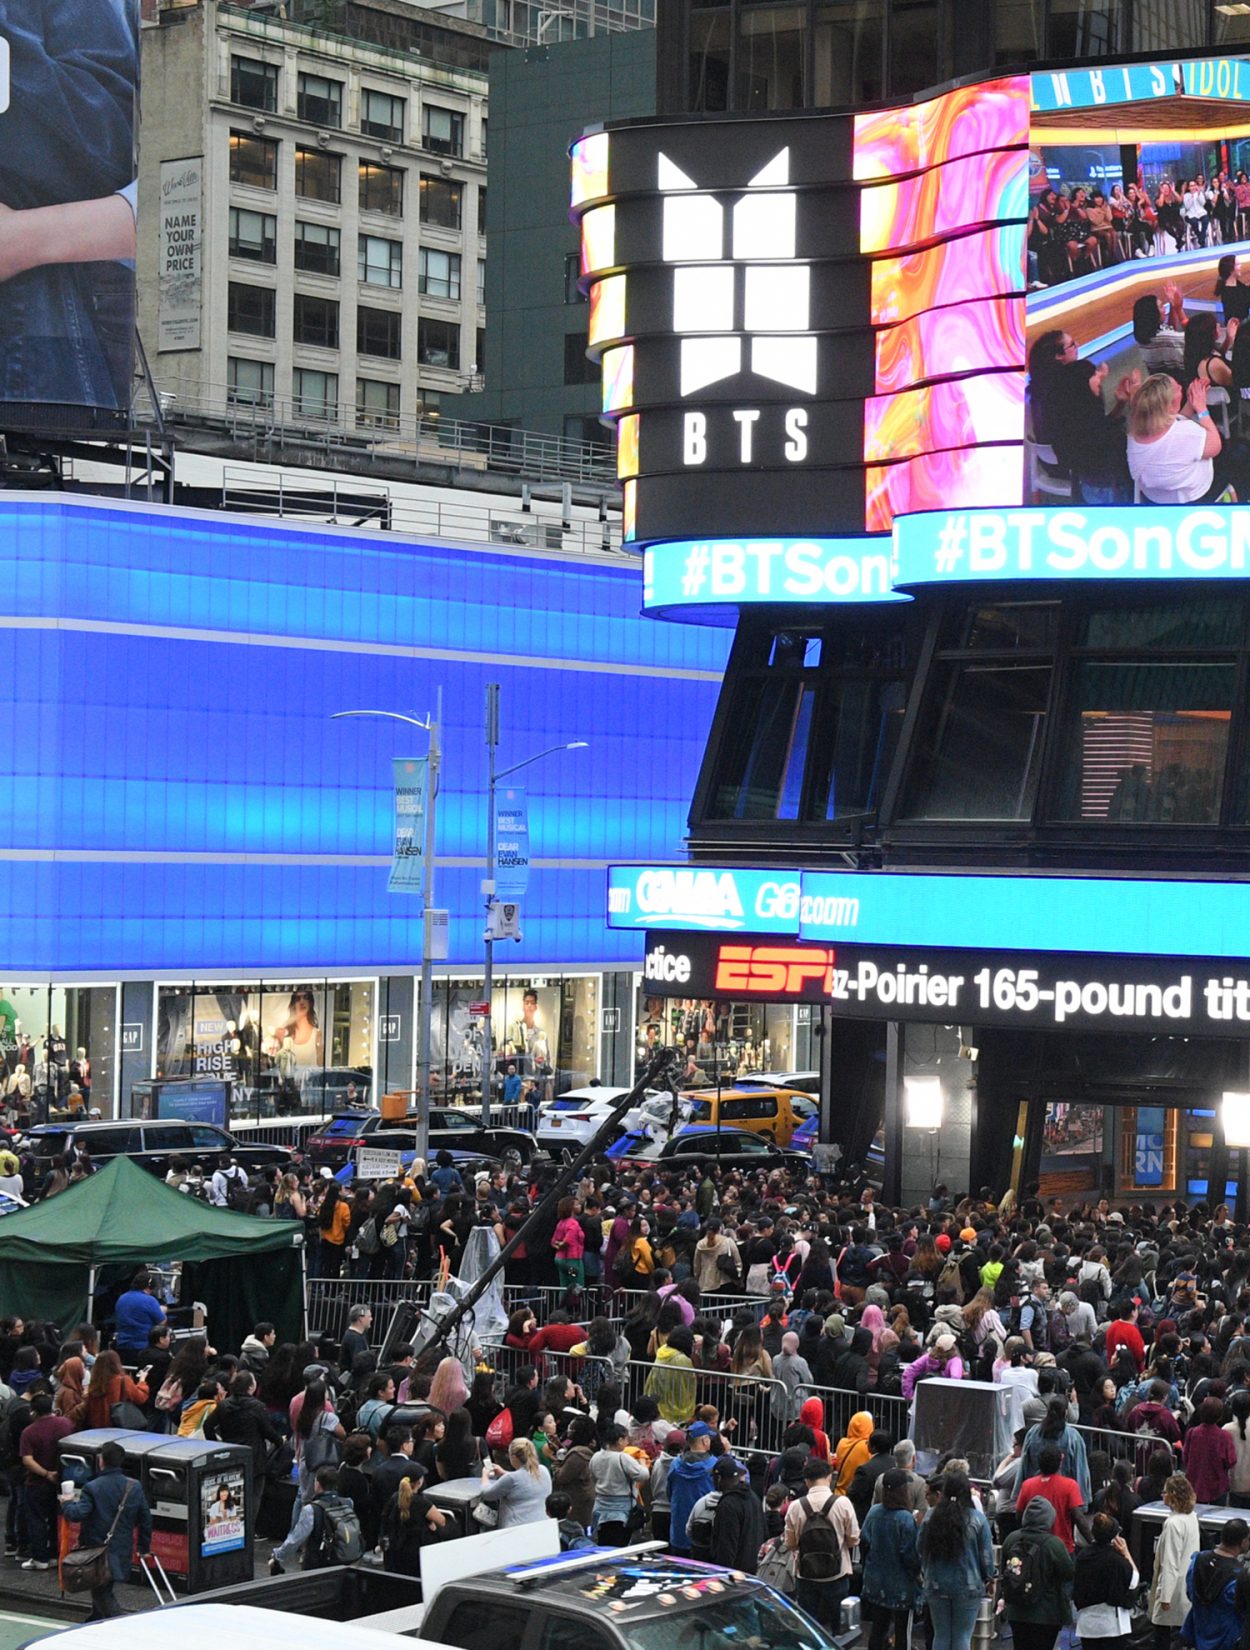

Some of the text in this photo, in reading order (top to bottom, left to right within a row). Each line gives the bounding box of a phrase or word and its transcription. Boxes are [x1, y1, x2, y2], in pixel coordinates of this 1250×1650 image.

[165, 214, 196, 229] NAME
[166, 229, 194, 243] YOUR
[167, 243, 194, 257] OWN
[166, 258, 194, 271] PRICE
[683, 408, 808, 465] BTS
[681, 542, 892, 597] #BTSon
[498, 858, 528, 866] HANSEN
[974, 968, 1191, 1023] 165-pound
[196, 1056, 232, 1071] RISE
